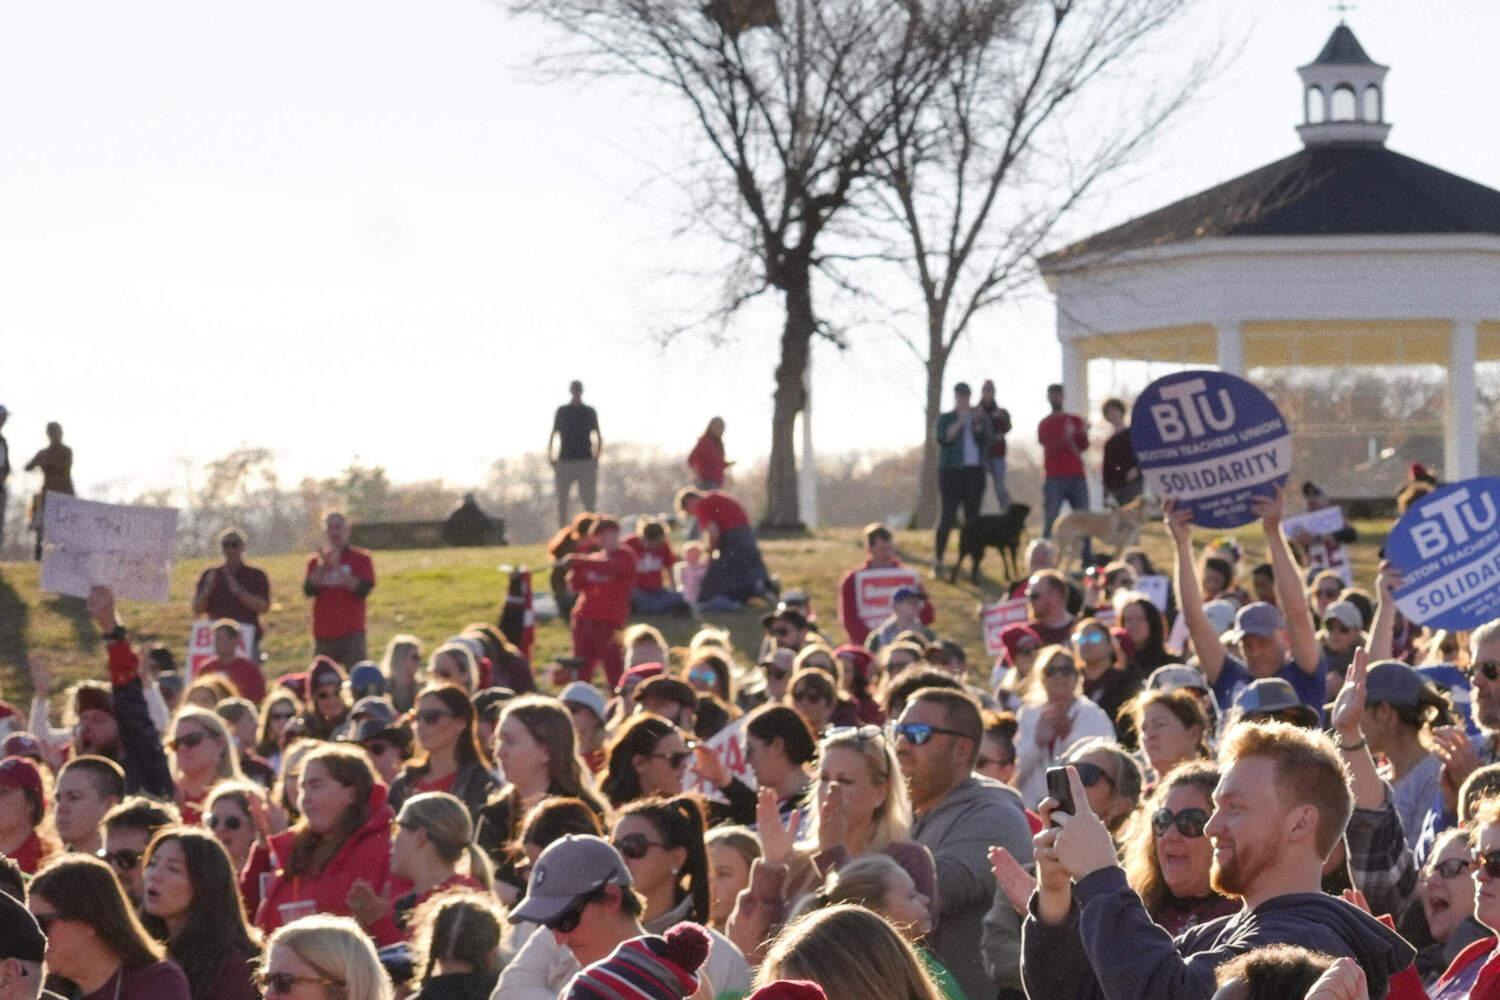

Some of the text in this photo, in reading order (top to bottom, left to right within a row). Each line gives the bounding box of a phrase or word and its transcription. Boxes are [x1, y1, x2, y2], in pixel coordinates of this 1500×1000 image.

[1151, 377, 1237, 443] BTU
[1159, 448, 1279, 494] SOLIDARITY
[1409, 487, 1497, 560] BTU
